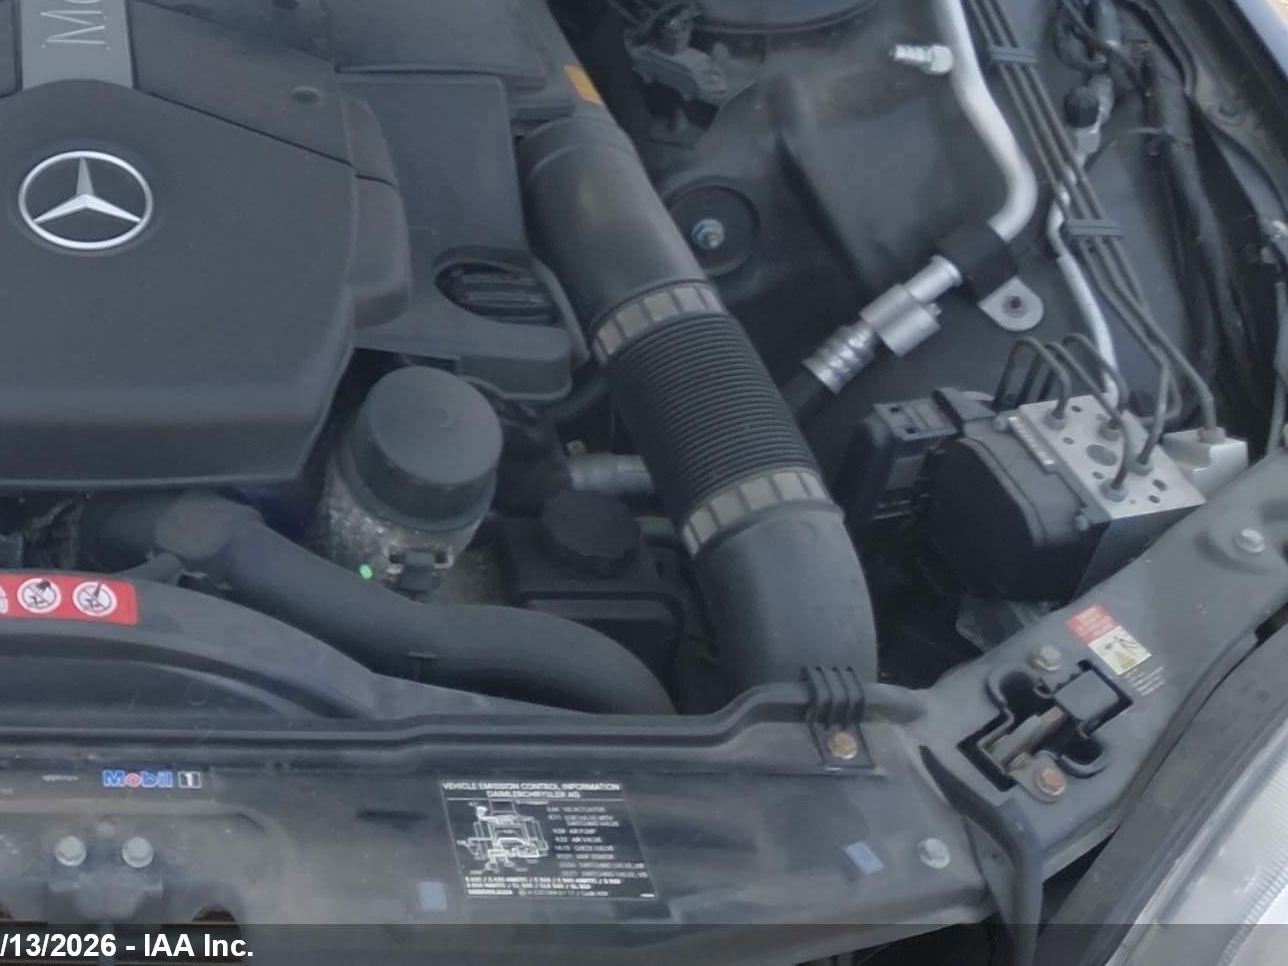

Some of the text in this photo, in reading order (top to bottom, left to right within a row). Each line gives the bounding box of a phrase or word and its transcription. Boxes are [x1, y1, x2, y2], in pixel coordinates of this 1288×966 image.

[102, 770, 173, 788] Mobil
[521, 783, 560, 791] CONTROL
[561, 783, 621, 791] INFORMATION
